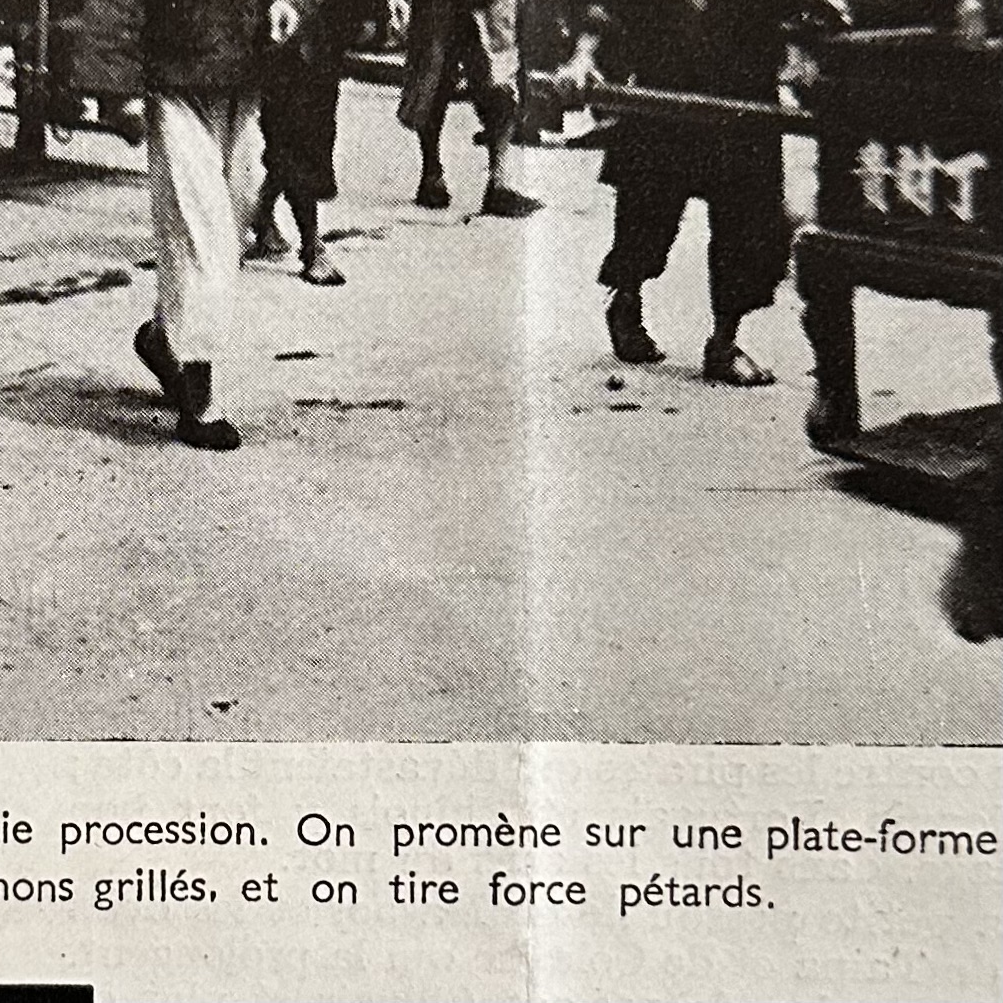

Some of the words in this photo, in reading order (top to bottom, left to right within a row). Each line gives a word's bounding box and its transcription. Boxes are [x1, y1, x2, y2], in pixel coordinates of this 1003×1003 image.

[61, 811, 268, 854] procession.
[297, 812, 355, 846] On
[393, 811, 561, 856] promène
[585, 822, 647, 847] sur
[672, 823, 742, 849] une
[767, 815, 998, 859] plate-forme
[94, 867, 217, 910] grillés,
[241, 872, 279, 902] et
[311, 879, 358, 904] on
[388, 870, 459, 904] tire
[488, 871, 586, 906] force
[620, 873, 774, 916] pétards.
